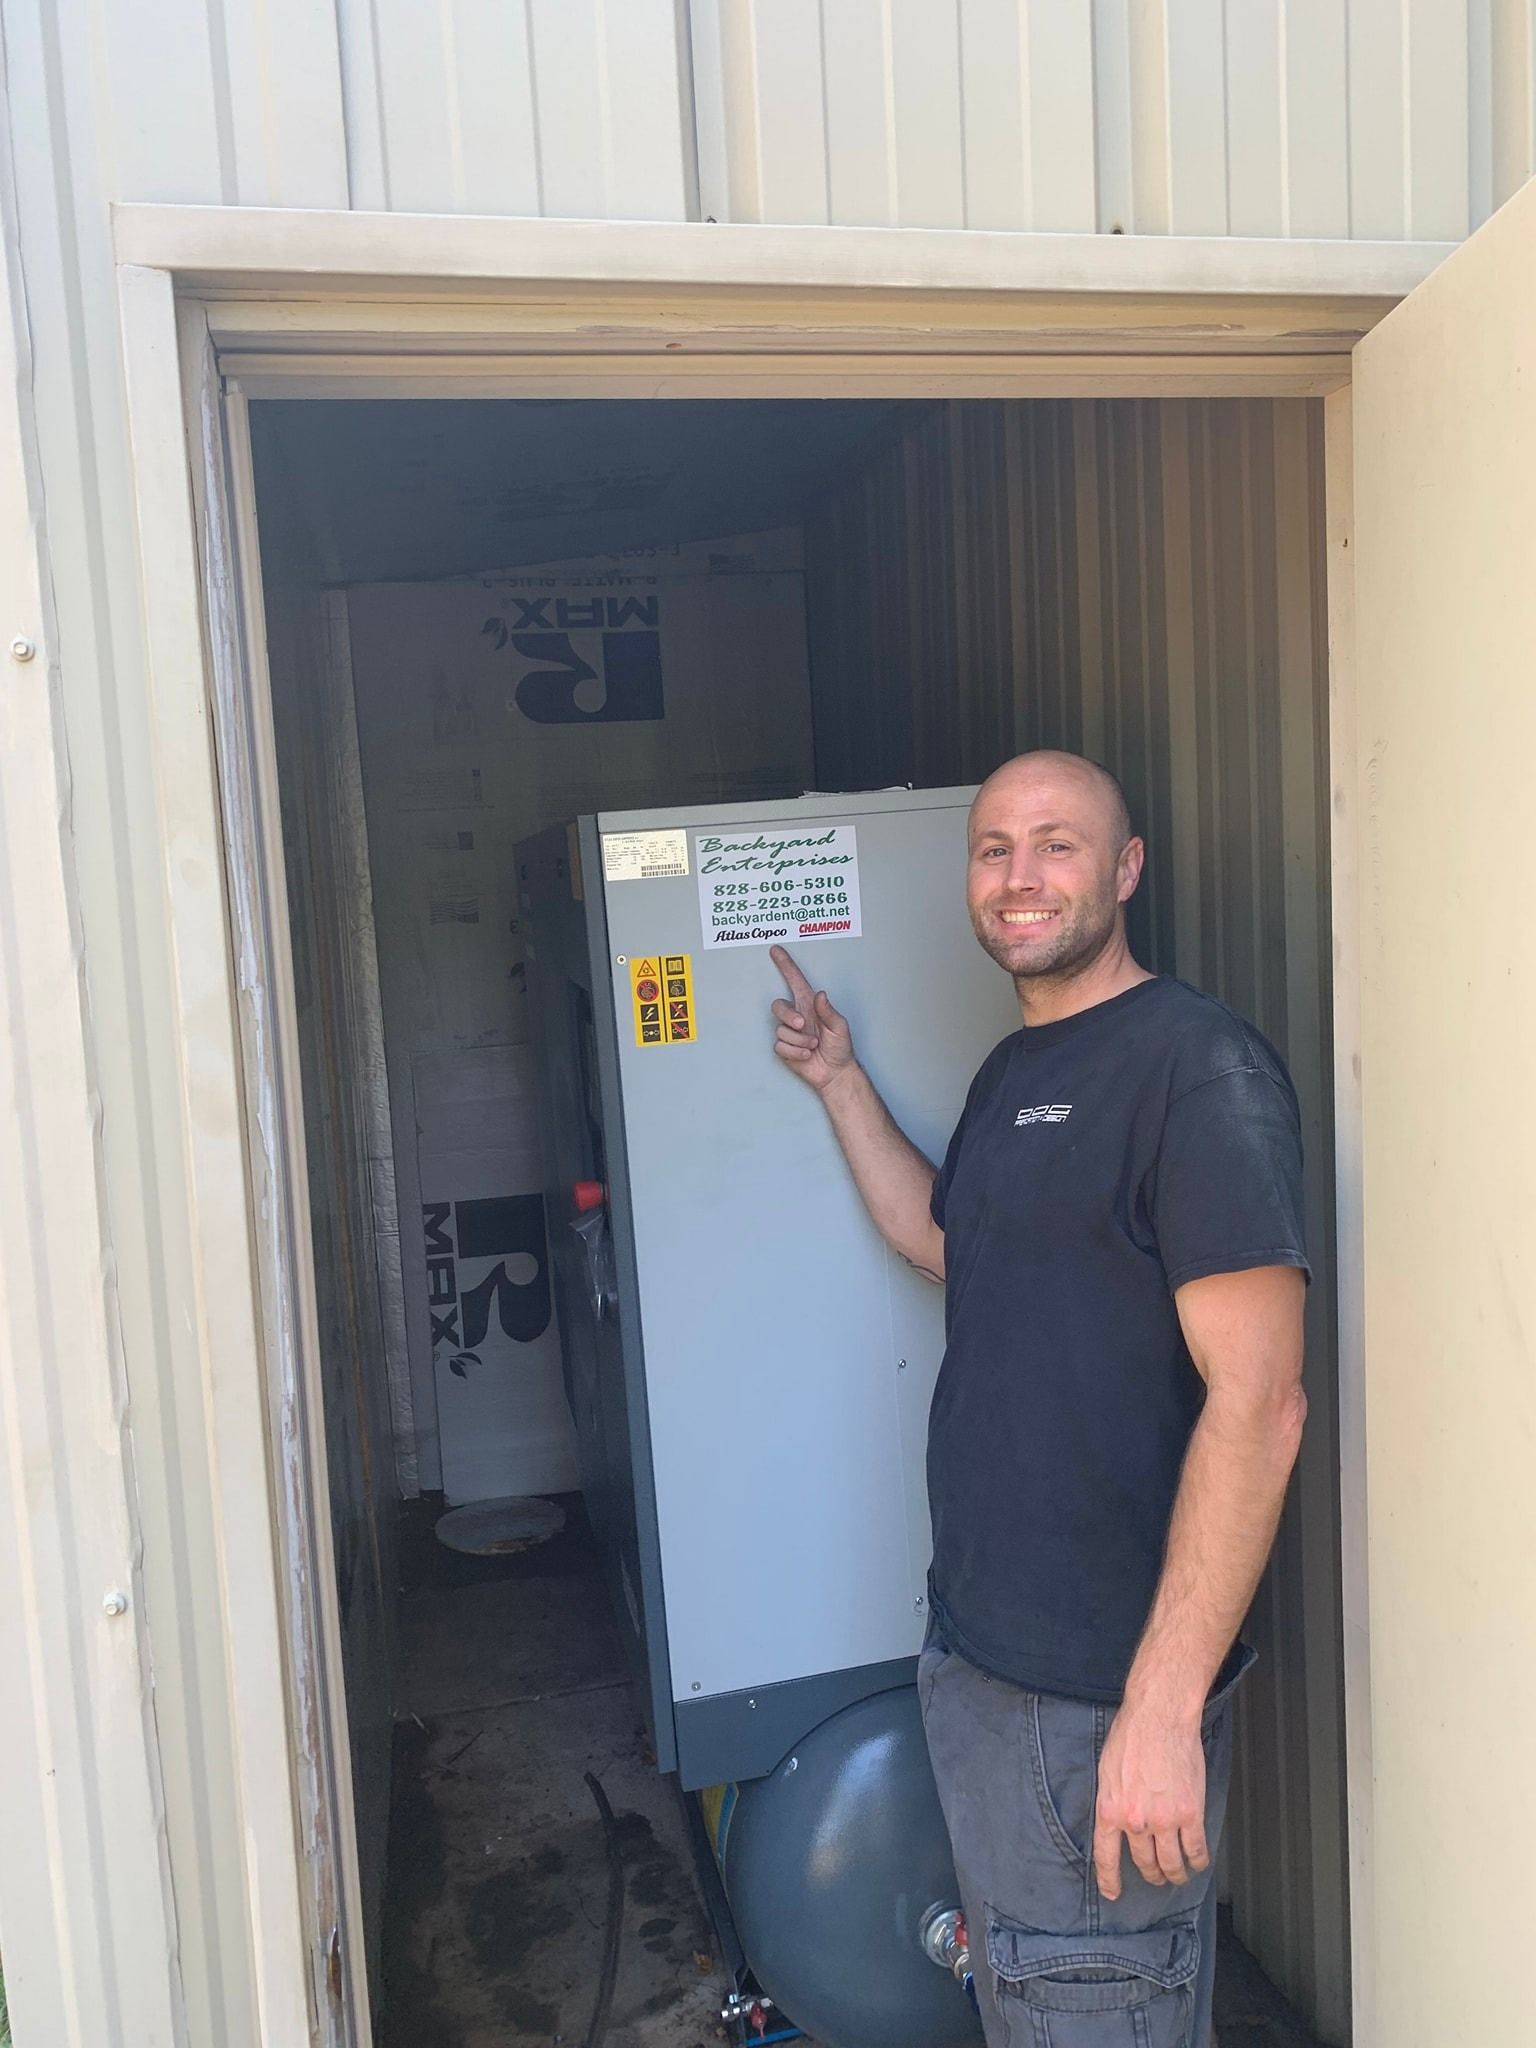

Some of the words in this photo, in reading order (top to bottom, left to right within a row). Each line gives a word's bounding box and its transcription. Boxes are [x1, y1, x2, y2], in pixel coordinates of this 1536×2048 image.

[511, 596, 659, 629] MAX
[511, 630, 665, 724] R
[699, 830, 836, 859] Backyard
[701, 854, 854, 875] Enterprises
[714, 876, 845, 896] 828-606-5310
[713, 892, 848, 913] 828-223-0866
[712, 905, 851, 926] backyardent@att.net
[713, 929, 750, 943] Atlas
[752, 927, 788, 940] Copco
[799, 920, 851, 934] CHAMPION
[423, 1201, 461, 1349] MAX
[455, 1193, 552, 1349] R
